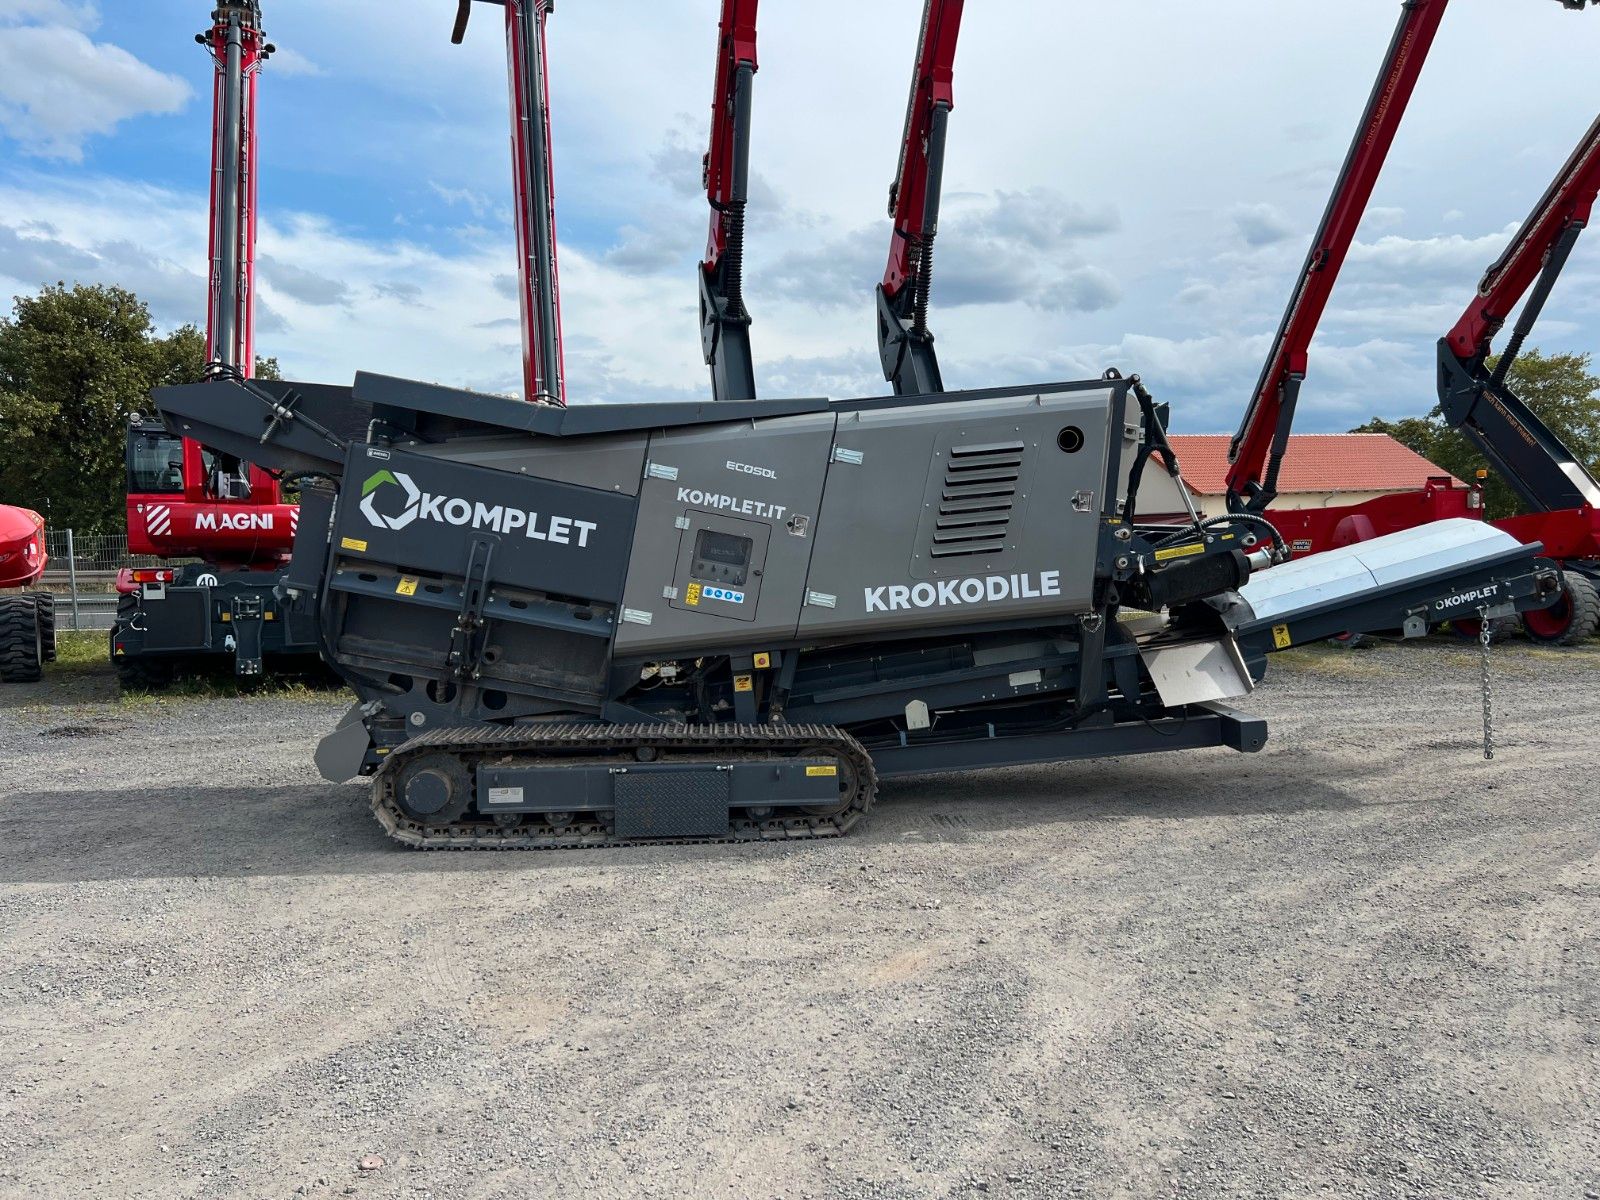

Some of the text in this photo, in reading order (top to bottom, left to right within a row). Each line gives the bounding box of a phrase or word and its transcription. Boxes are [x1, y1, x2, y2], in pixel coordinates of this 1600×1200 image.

[1366, 30, 1414, 145] mich kann man mieten!
[419, 492, 598, 548] KOMPLET
[677, 487, 787, 520] KOMPLET.IT
[195, 513, 273, 532] MAGNI
[199, 576, 215, 587] 40
[864, 570, 1061, 612] KROKODILE
[1444, 584, 1498, 608] KOMPLET
